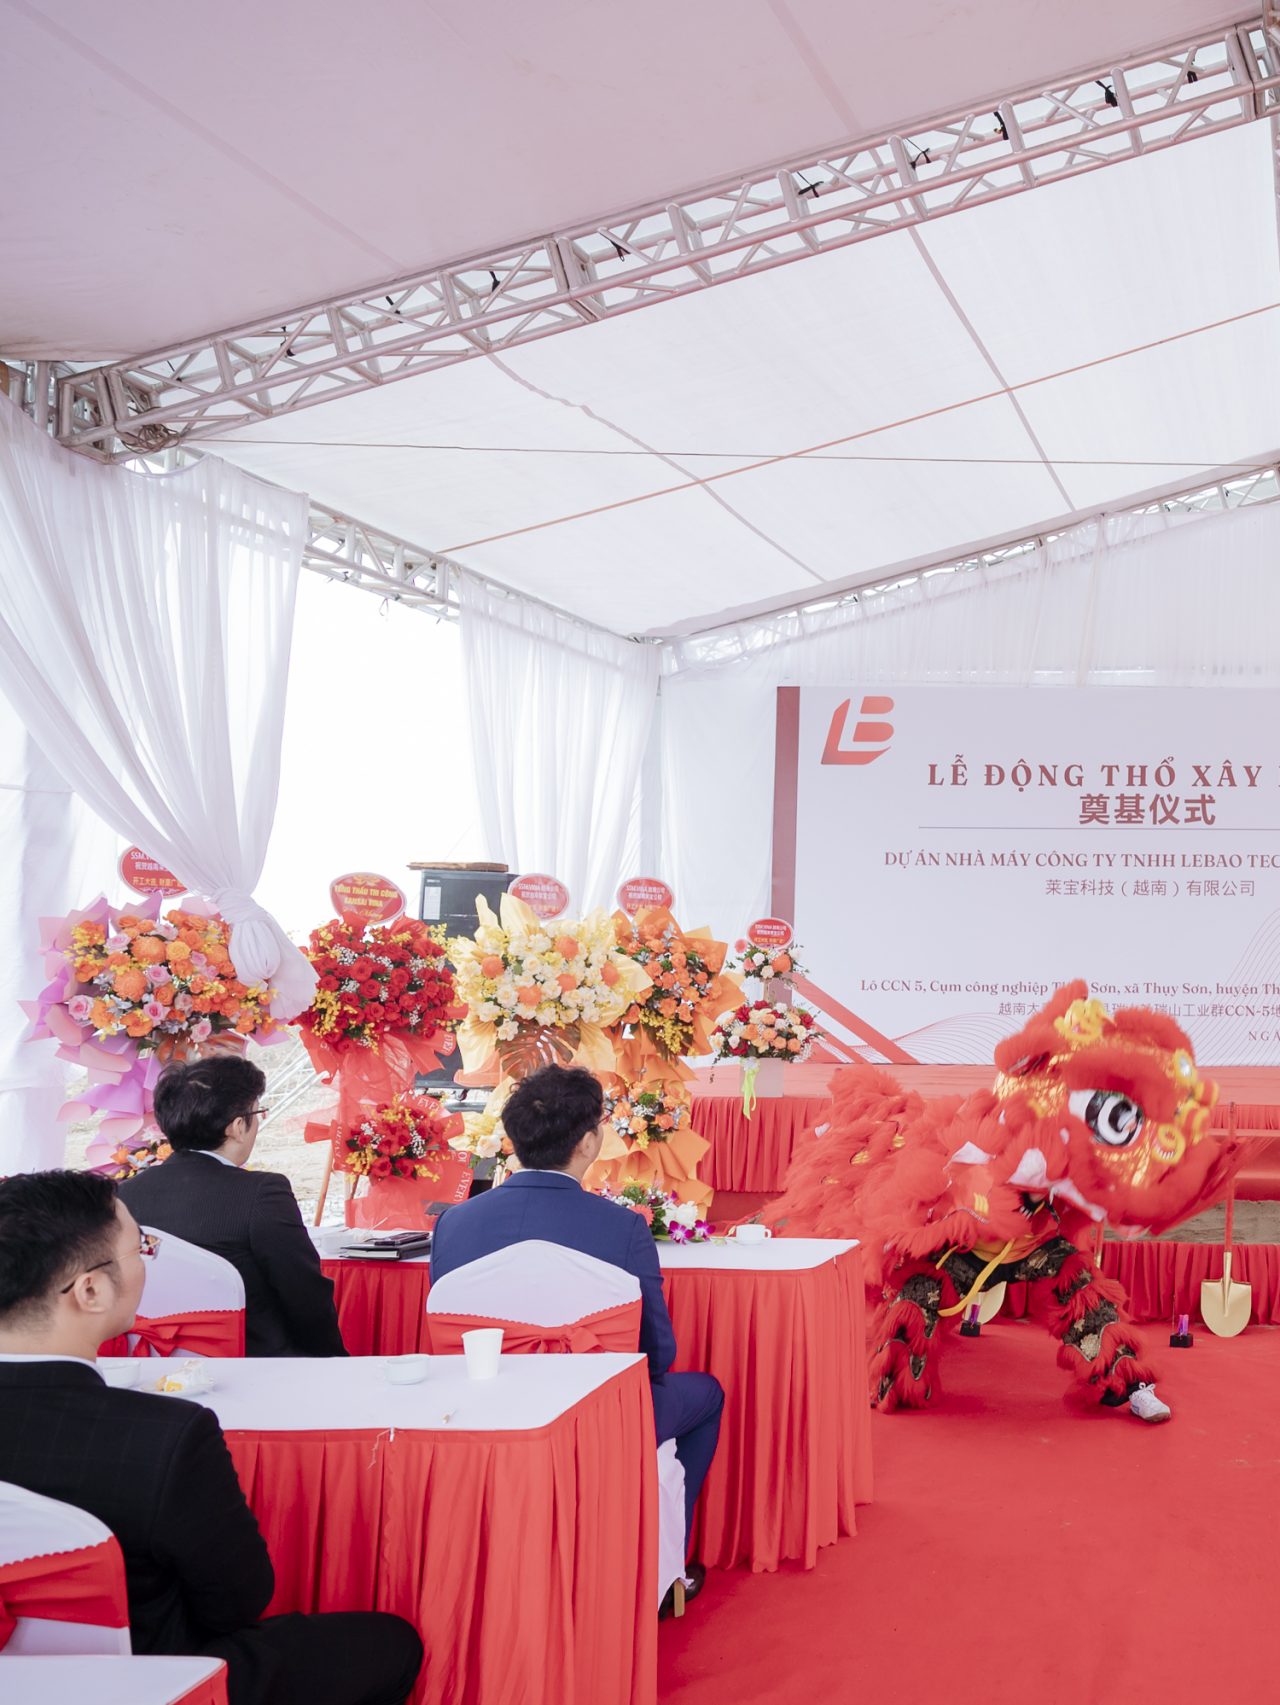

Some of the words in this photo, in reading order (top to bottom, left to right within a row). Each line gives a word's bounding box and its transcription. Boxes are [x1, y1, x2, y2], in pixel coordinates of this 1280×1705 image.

[927, 753, 969, 787] LỄ
[984, 758, 1085, 793] ĐỘNG
[1101, 755, 1176, 788] THỔ
[1191, 759, 1263, 788] XÂY
[1078, 793, 1217, 826] 奠基仪式
[884, 850, 912, 870] DỰ
[914, 849, 941, 867] ÁN
[945, 850, 986, 867] NHÀ
[990, 850, 1032, 867] MÁY
[1035, 850, 1089, 868] CÔNG
[1092, 853, 1117, 868] TY
[1120, 853, 1176, 868] TNHH
[1180, 854, 1243, 869] LEBAO
[861, 979, 878, 991] Lô
[880, 980, 911, 992] CCN
[914, 980, 927, 993] 5,
[929, 981, 962, 995] Cụm
[965, 982, 999, 996] công
[1001, 981, 1049, 996] nghiệp
[1091, 981, 1121, 996] Sơn,
[1124, 982, 1140, 994] xã
[1143, 982, 1179, 997] Thụy
[1182, 982, 1213, 996] Sơn,
[1215, 982, 1258, 998] huyện
